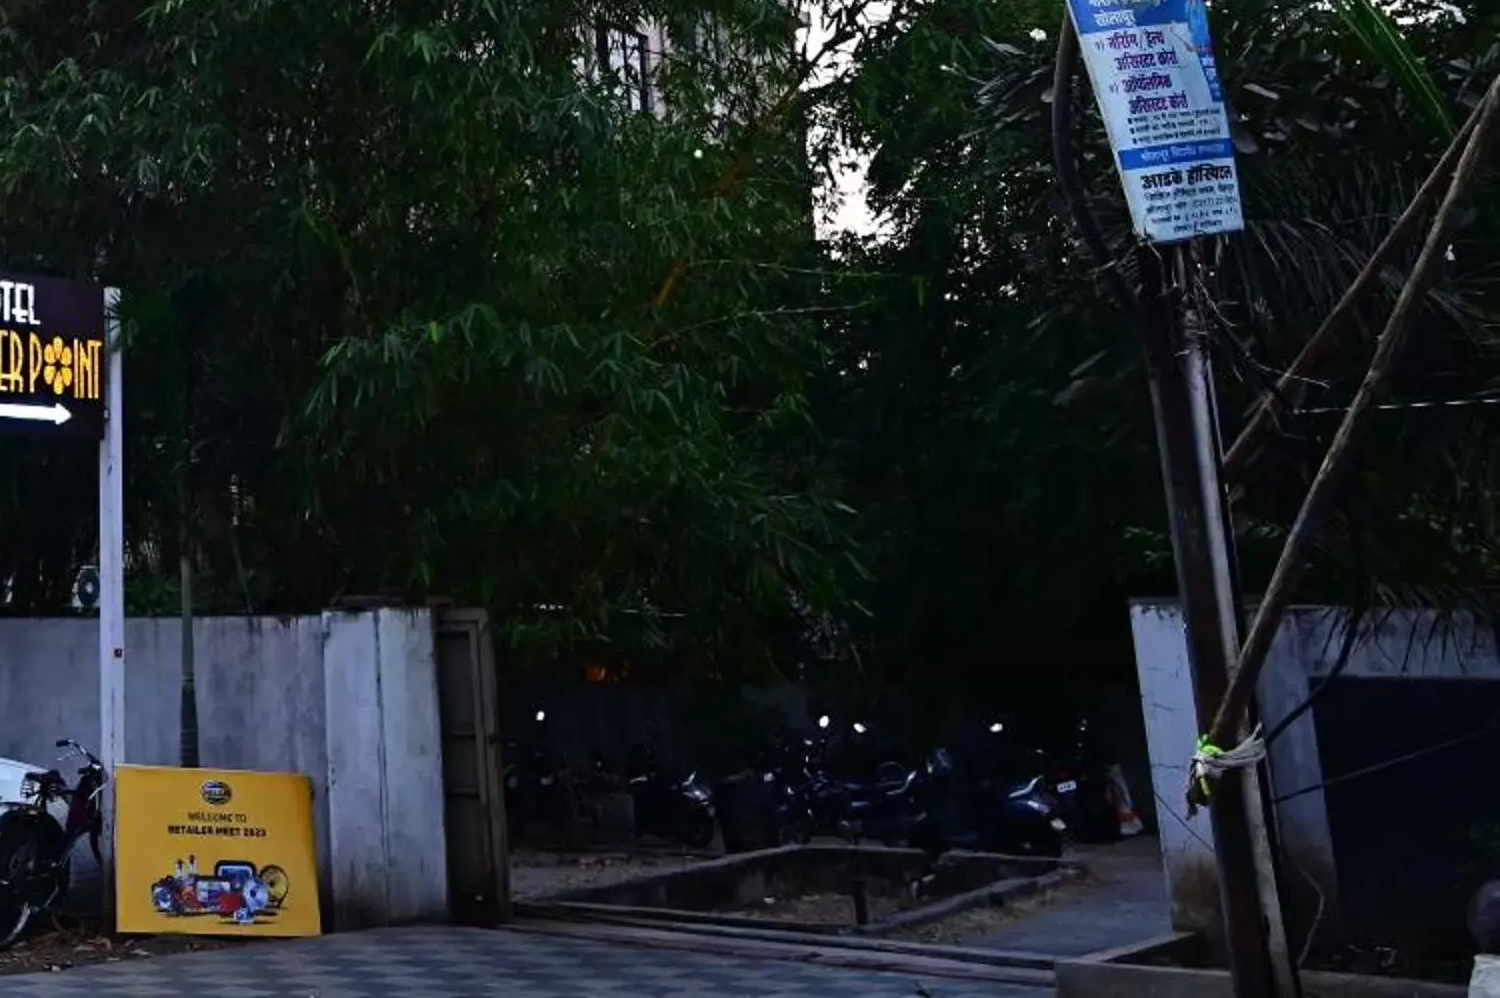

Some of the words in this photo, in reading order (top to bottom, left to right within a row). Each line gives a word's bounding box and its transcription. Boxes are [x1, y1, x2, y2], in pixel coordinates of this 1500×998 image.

[1186, 163, 1233, 185] हॉस्पिटल
[29, 331, 103, 399] POINT
[188, 811, 233, 823] WELCOME
[235, 813, 248, 823] TO
[167, 824, 213, 835] RETAILER
[216, 826, 241, 836] MEET
